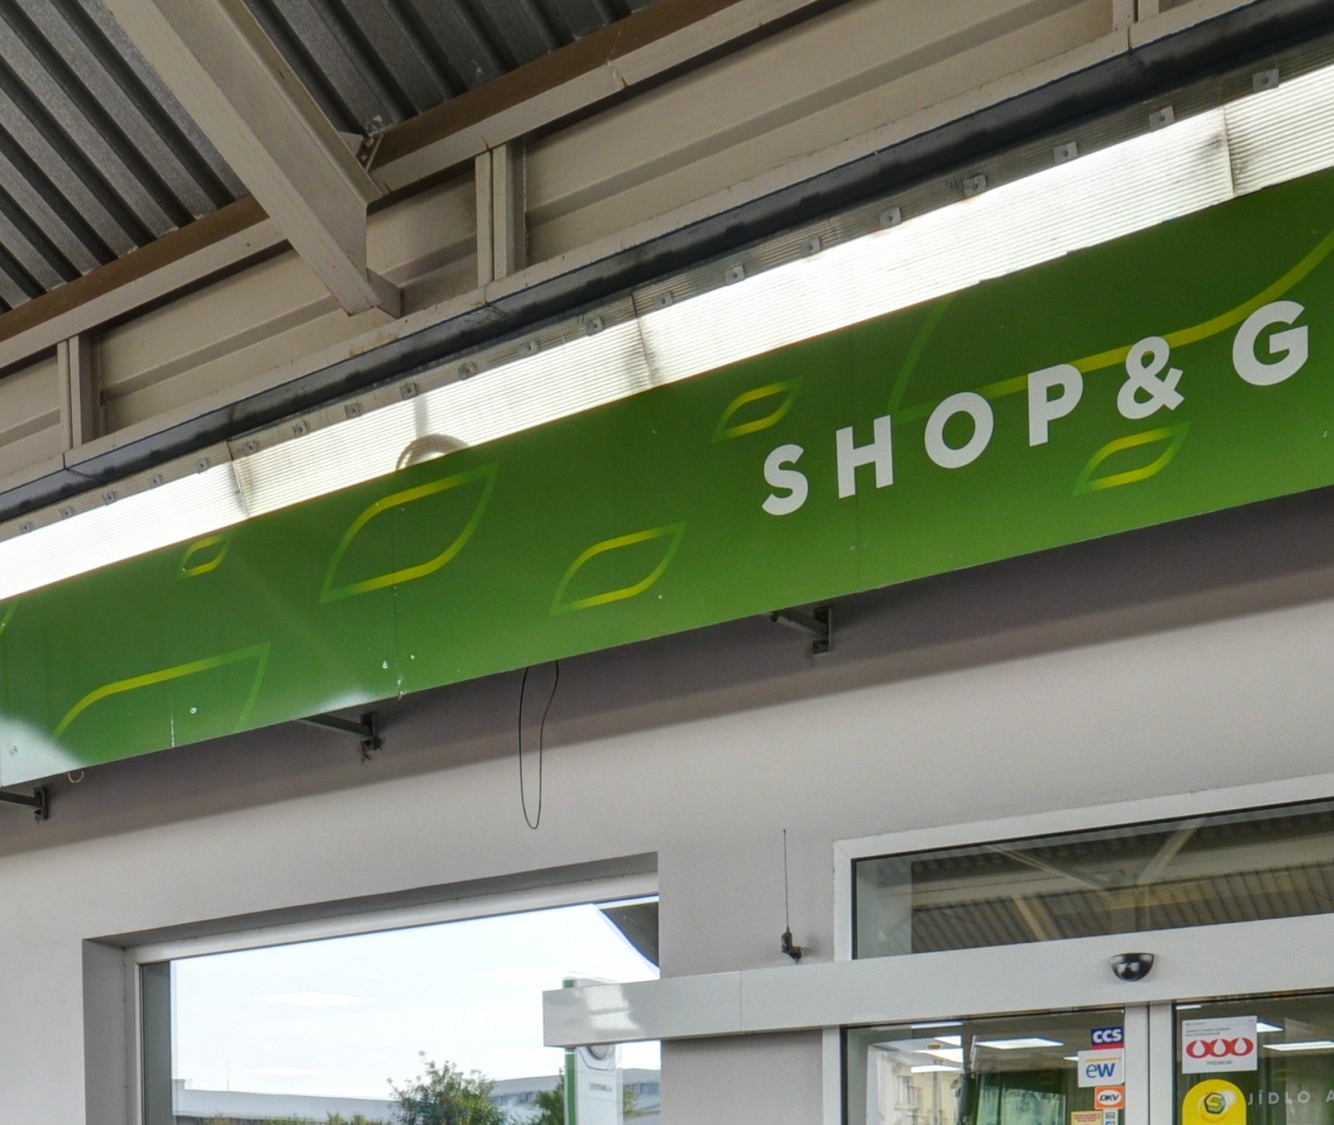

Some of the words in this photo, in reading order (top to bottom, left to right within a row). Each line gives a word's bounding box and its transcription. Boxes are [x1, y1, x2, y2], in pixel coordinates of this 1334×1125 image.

[1092, 1028, 1122, 1043] CCS
[1085, 1063, 1116, 1078] ew
[1099, 1094, 1120, 1102] DKV
